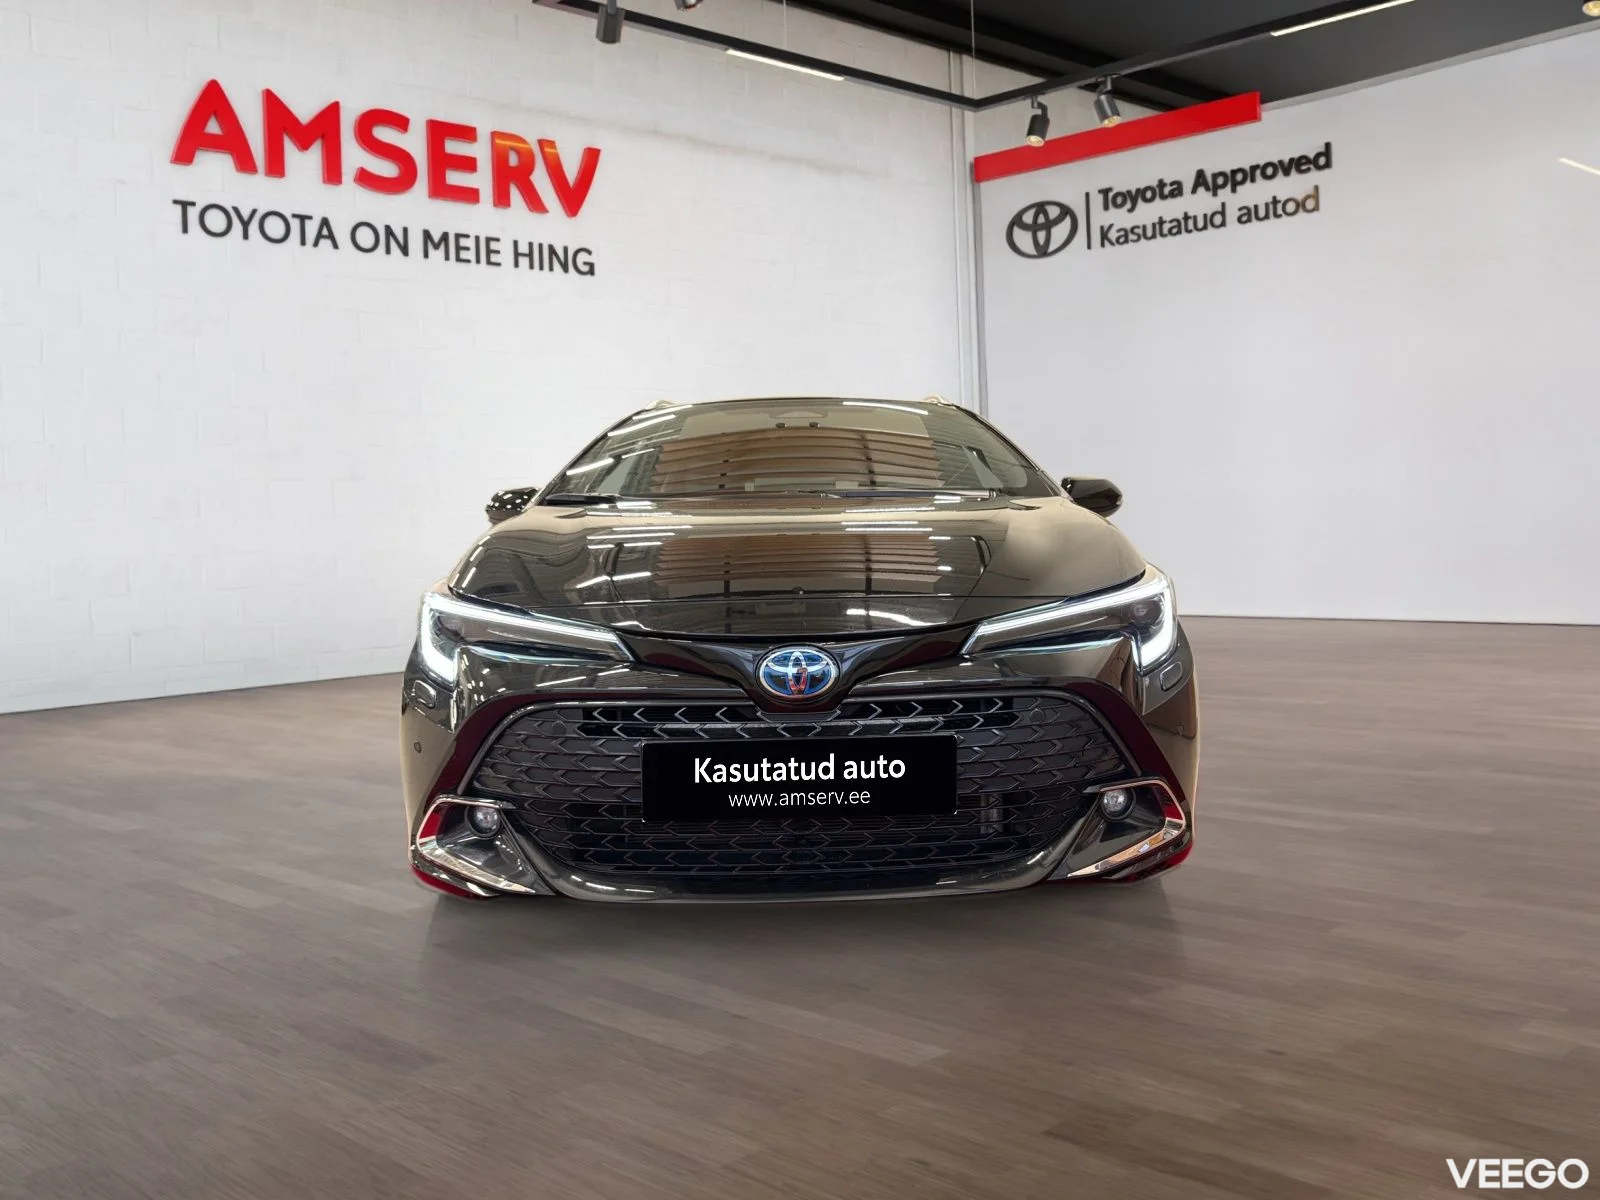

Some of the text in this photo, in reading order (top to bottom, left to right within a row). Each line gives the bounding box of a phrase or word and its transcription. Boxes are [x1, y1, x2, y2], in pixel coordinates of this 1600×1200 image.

[170, 78, 601, 218] AMSERV
[1099, 142, 1333, 213] Toyota Approved
[172, 199, 596, 276] TOYOTA ON MEIE HING
[1099, 185, 1320, 248] Kasutatud autod
[694, 753, 906, 783] Kasutatud auto
[728, 790, 871, 807] www.amserv.ee
